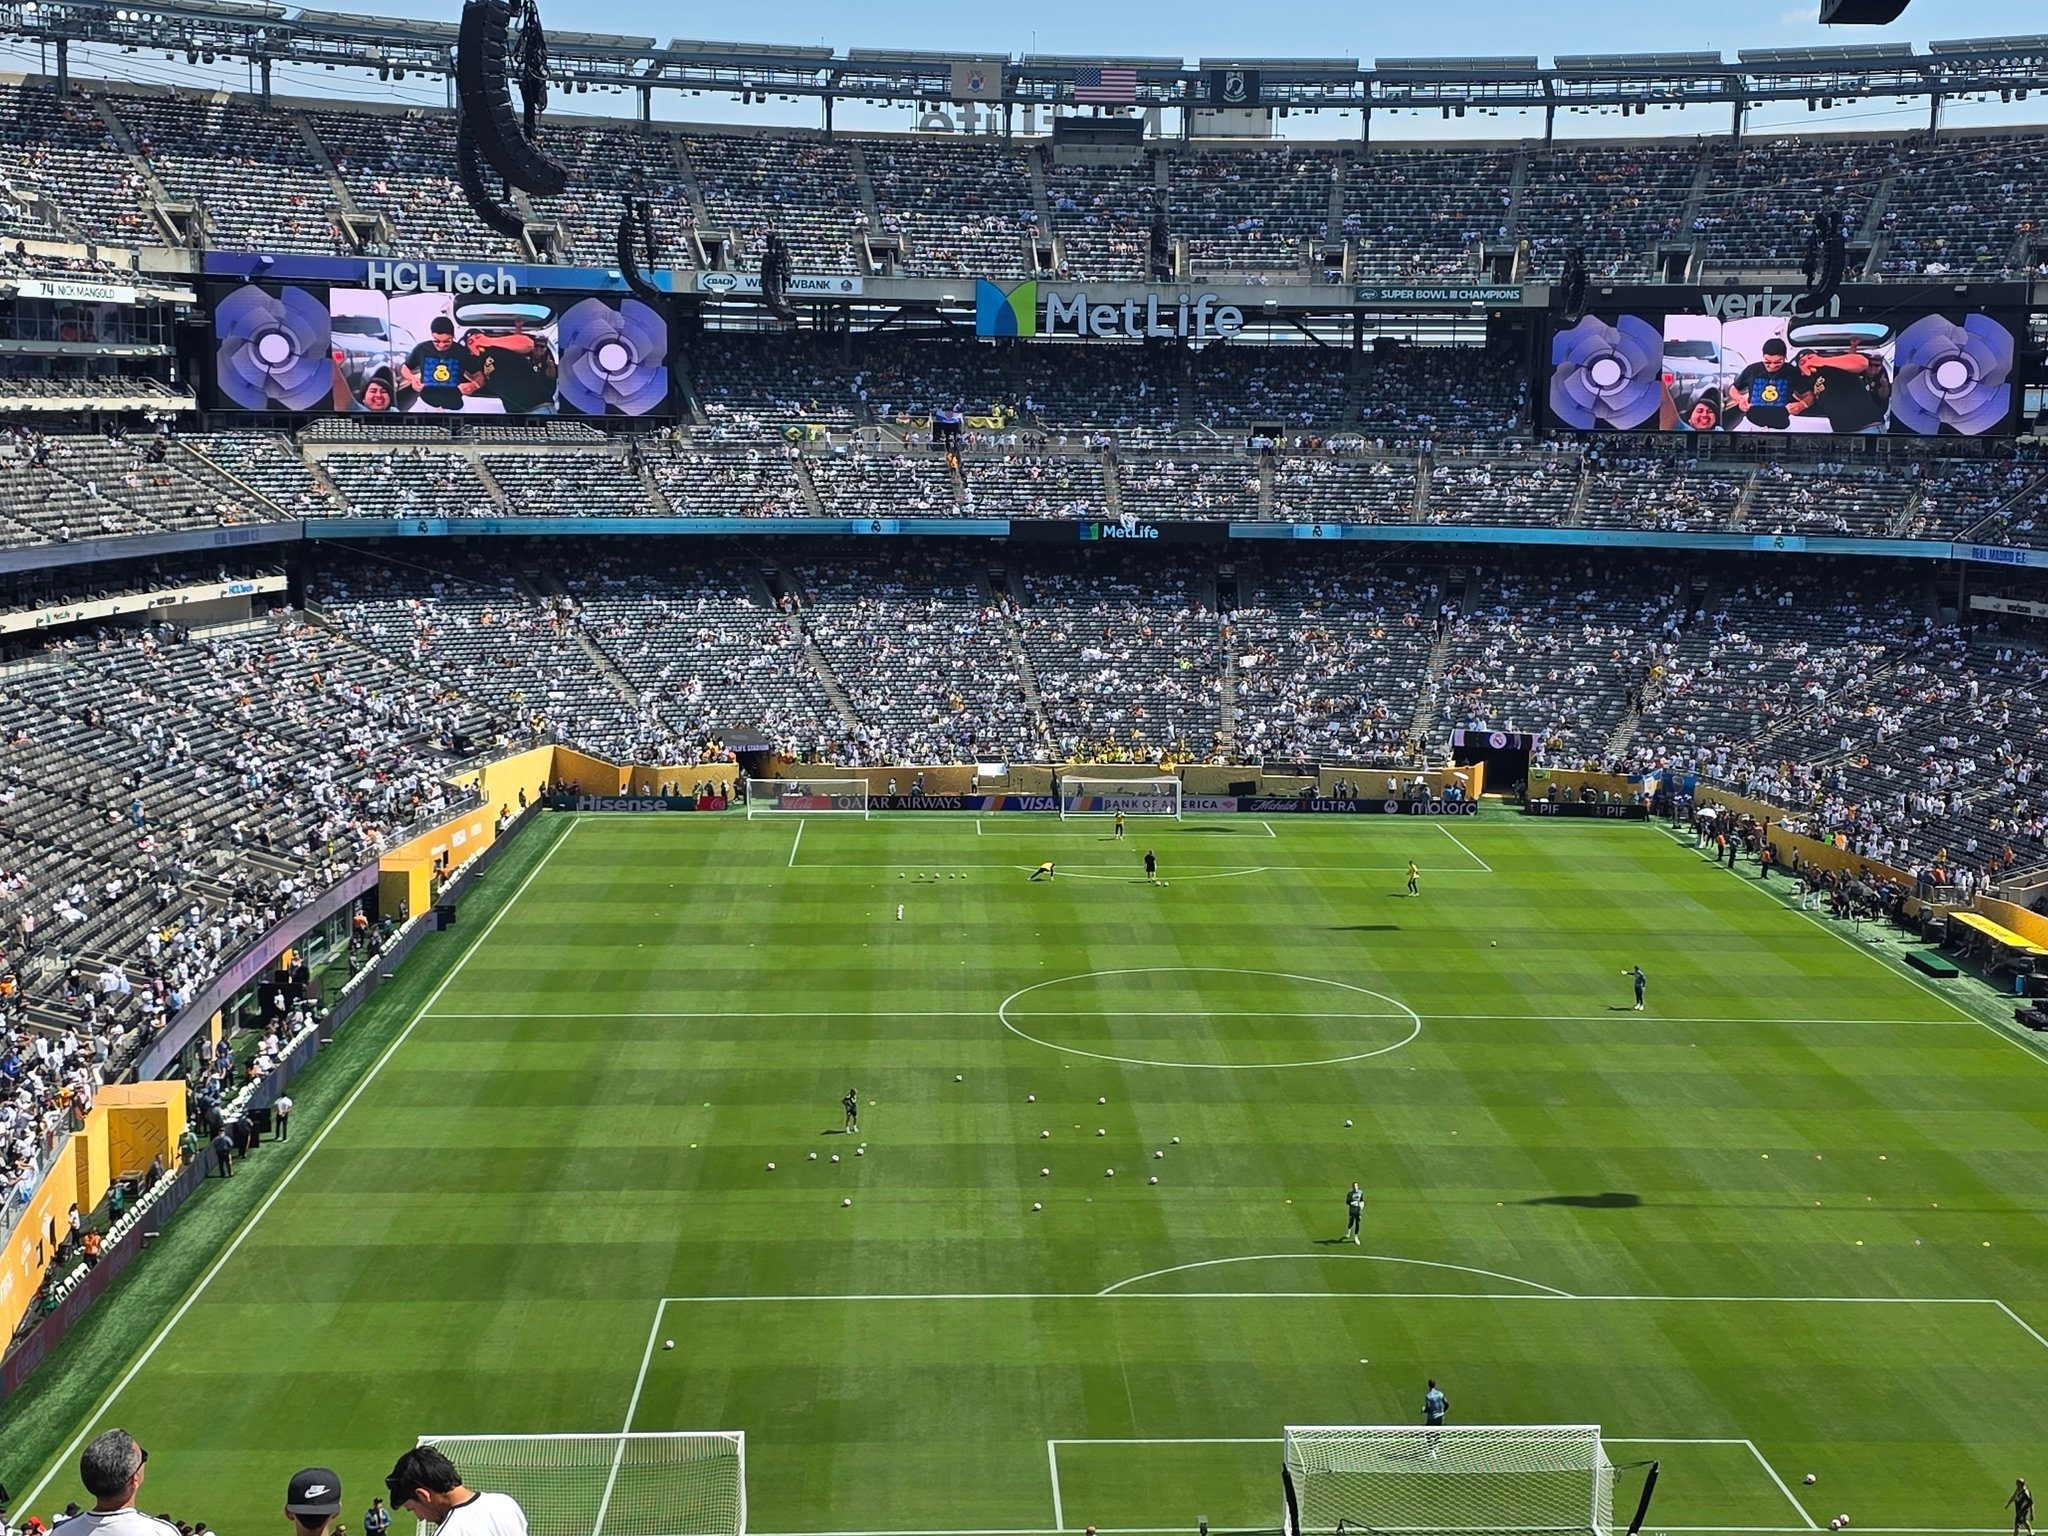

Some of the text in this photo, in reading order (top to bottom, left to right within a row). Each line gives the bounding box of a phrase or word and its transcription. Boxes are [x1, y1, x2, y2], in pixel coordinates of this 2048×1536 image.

[367, 261, 517, 296] HCLTech
[706, 278, 733, 286] COACH
[787, 279, 831, 290] WBANK
[39, 282, 115, 299] 74 NICK MANGOLD
[1381, 289, 1414, 299] SUPER
[1416, 290, 1448, 300] BOWL
[1458, 290, 1520, 300] CHAMPIONS
[1046, 292, 1244, 337] MetLife
[1103, 525, 1159, 539] MetLife
[578, 796, 667, 812] Hisense
[838, 796, 962, 810] QAAR AIRWAYS
[1018, 797, 1057, 810] VISA
[1104, 799, 1138, 810] BANK
[1142, 800, 1160, 810] OF
[1311, 800, 1356, 812] ULTRA
[1540, 803, 1560, 814] PIF
[1606, 806, 1627, 817] PIF
